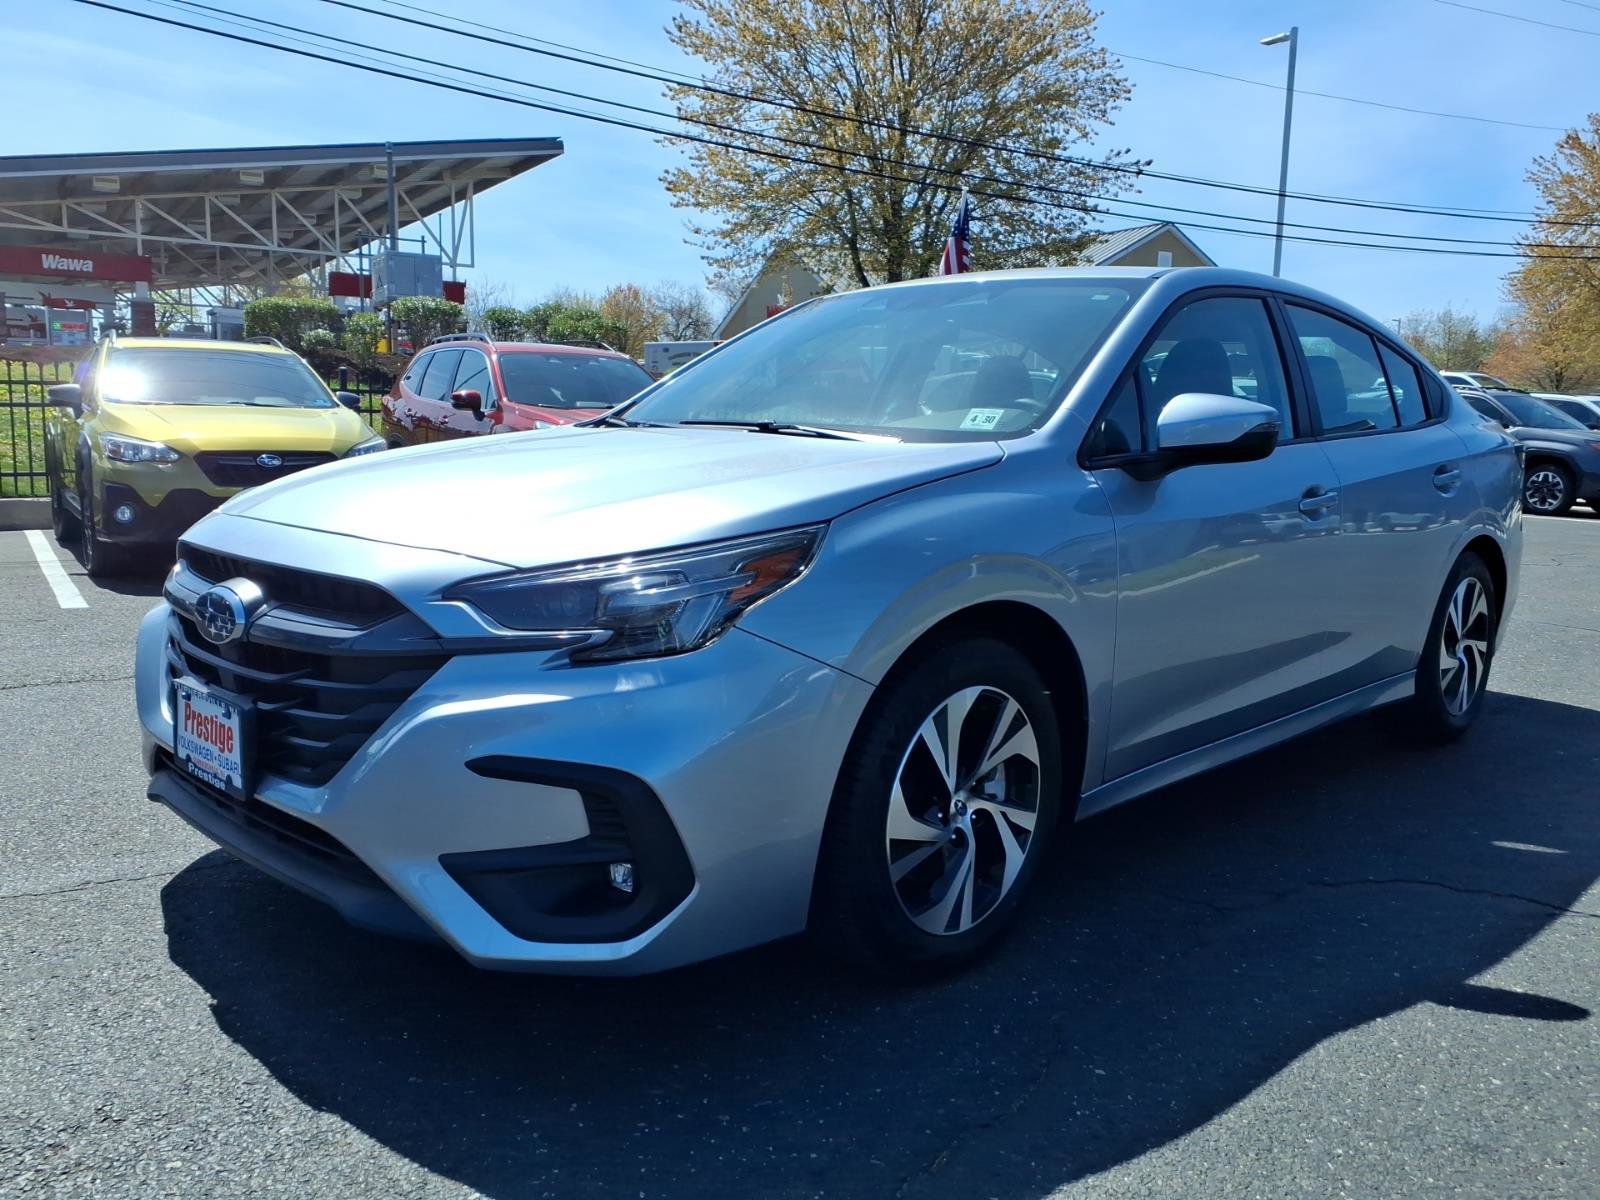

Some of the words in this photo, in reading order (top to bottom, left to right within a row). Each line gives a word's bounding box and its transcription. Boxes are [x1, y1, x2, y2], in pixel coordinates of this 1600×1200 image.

[41, 254, 93, 272] Wawa
[970, 414, 978, 423] 4
[982, 415, 997, 424] 30
[184, 701, 234, 754] Prestige
[177, 735, 214, 762] VOLKSWAGEN
[188, 762, 226, 790] Prestige
